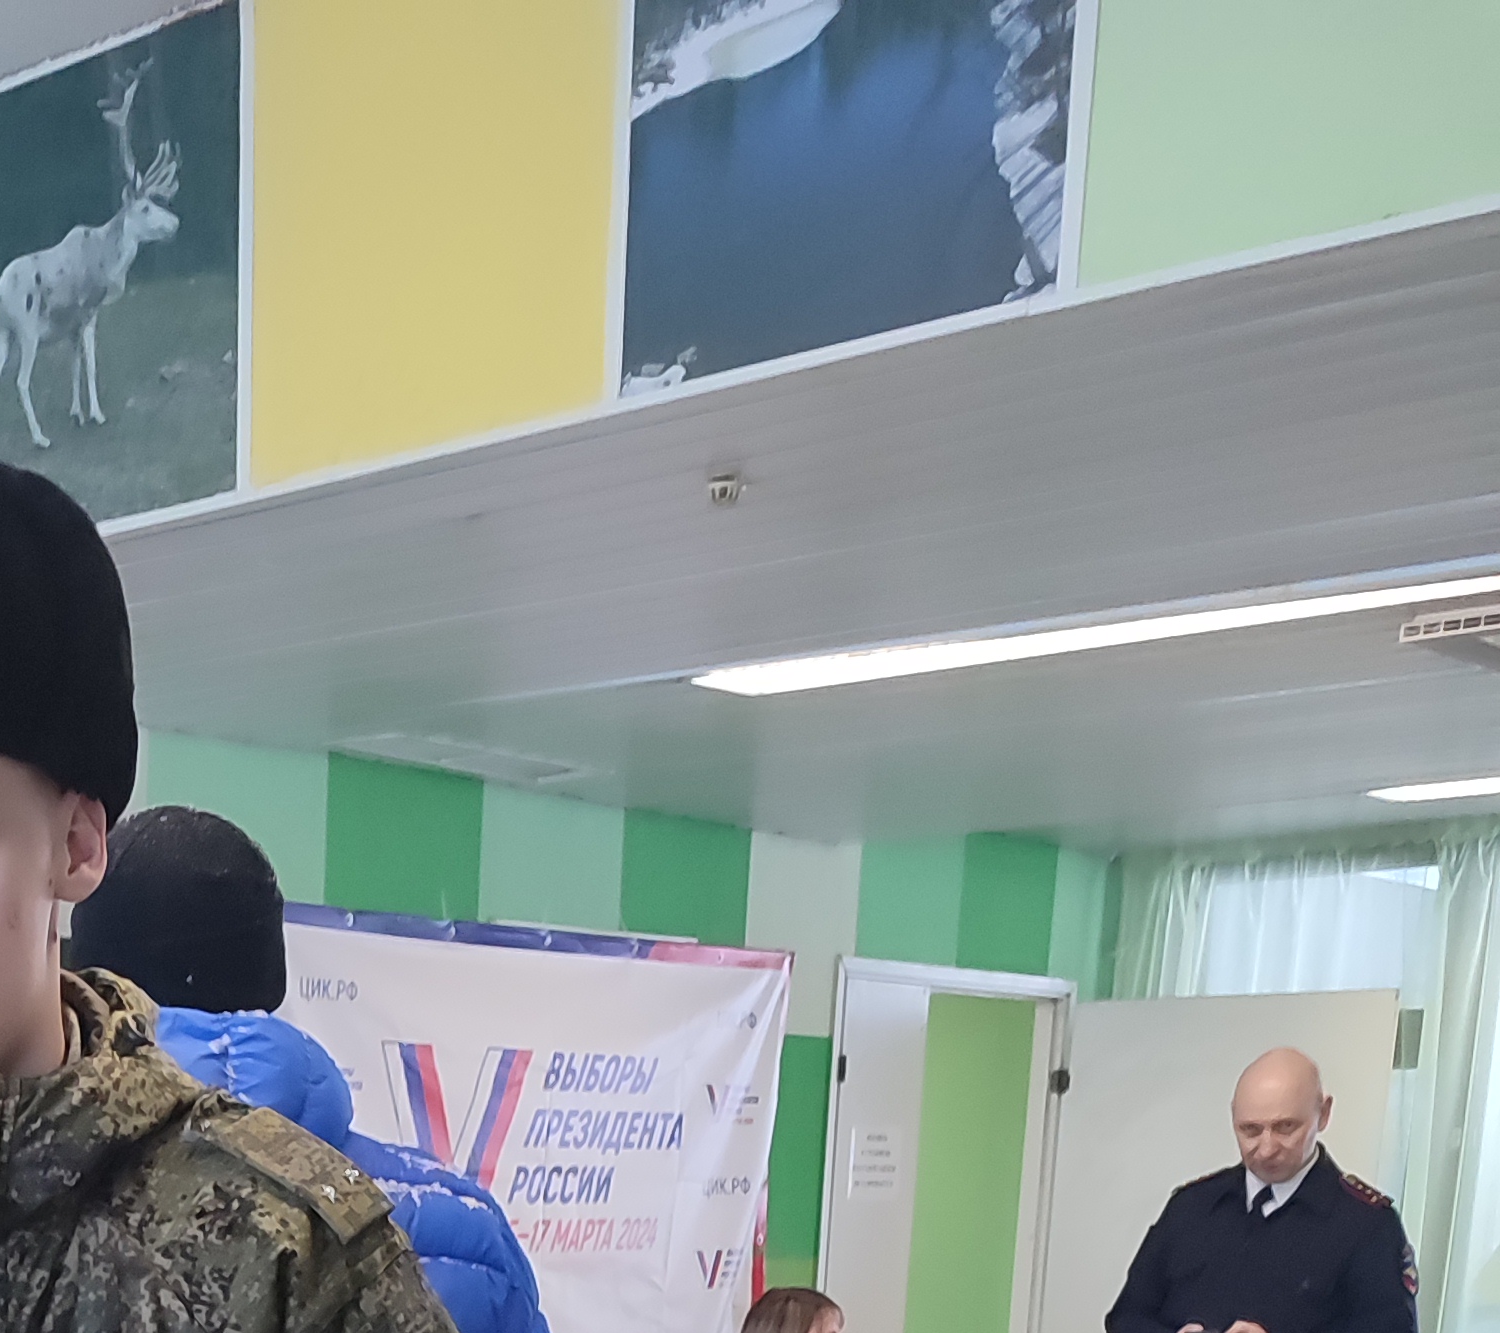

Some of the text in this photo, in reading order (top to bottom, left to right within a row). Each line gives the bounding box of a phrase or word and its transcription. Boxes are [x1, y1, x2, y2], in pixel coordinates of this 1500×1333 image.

[299, 976, 358, 1002] ЦИК.РФ
[543, 1051, 659, 1094] ВЫБОРЫ
[523, 1108, 684, 1156] ПРЕЗИДЕНТА
[507, 1165, 615, 1206] РОССИИ
[550, 1217, 615, 1253] МАРТА
[615, 1217, 659, 1250] 2024
